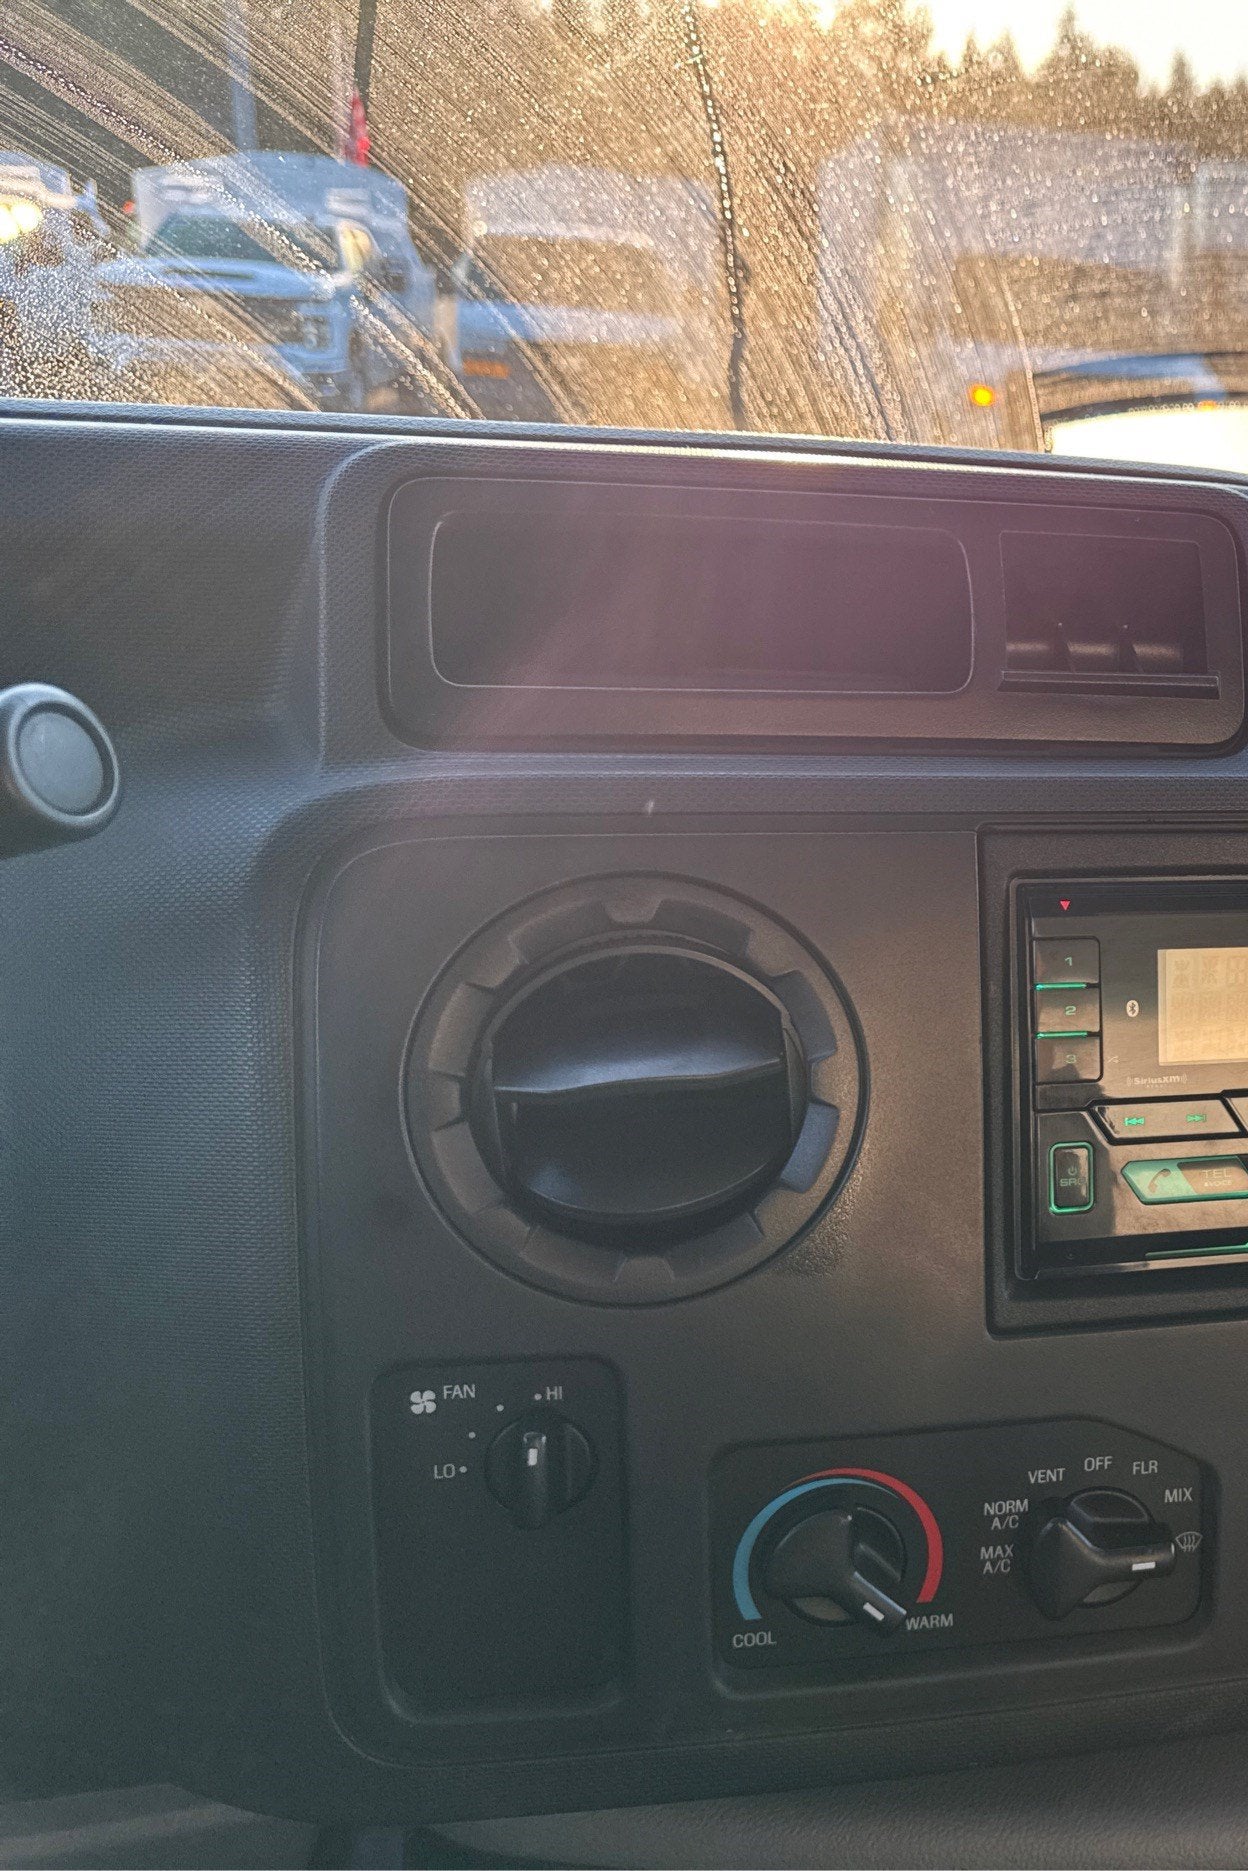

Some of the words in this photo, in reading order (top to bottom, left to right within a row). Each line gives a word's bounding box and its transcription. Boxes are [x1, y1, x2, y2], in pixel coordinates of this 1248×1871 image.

[1065, 1005, 1077, 1016] 2
[1065, 1054, 1077, 1064] 3
[1202, 1168, 1231, 1179] TEL
[443, 1384, 476, 1400] FAN
[545, 1386, 563, 1400] HI
[434, 1463, 456, 1479] LO
[1083, 1456, 1113, 1472] OFF
[1132, 1460, 1158, 1475] FLR
[1027, 1468, 1066, 1484] VENT
[1164, 1487, 1193, 1503] MIX
[983, 1499, 1029, 1516] NORM
[991, 1515, 1019, 1530] A/C
[980, 1544, 1014, 1560] MAX
[982, 1559, 1011, 1575] A/C
[906, 1613, 954, 1631] WARM
[732, 1631, 777, 1649] COOL
